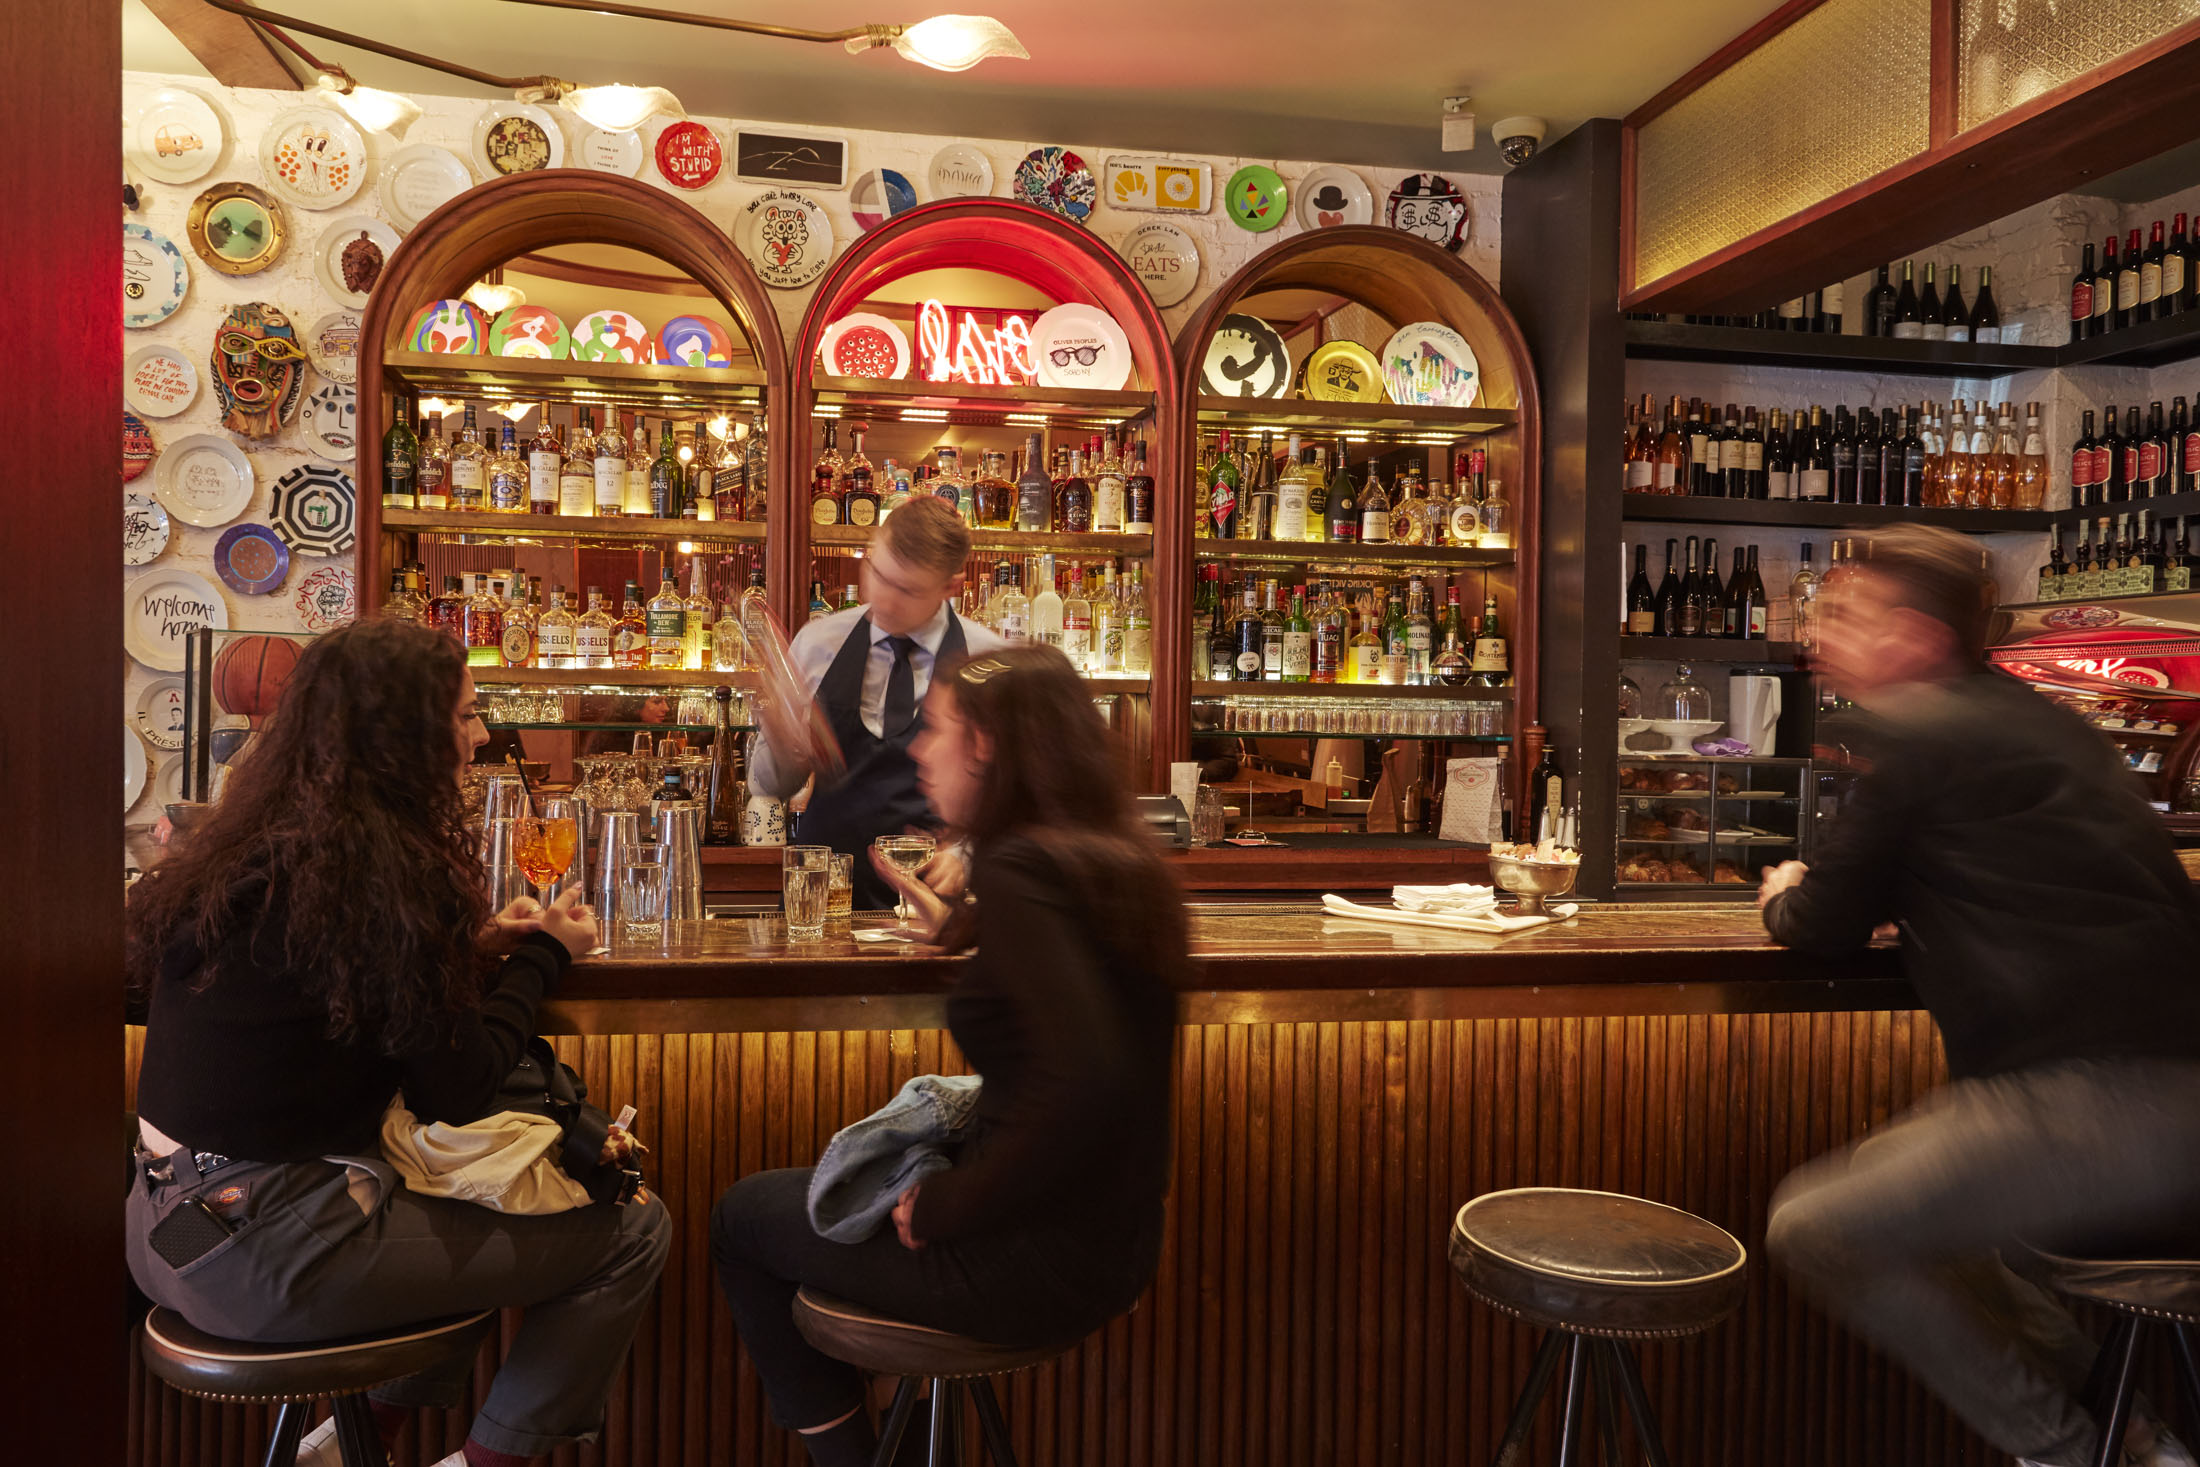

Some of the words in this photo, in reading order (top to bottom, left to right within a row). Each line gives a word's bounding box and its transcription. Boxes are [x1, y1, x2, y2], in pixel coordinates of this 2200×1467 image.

[682, 145, 711, 157] WITH
[670, 157, 712, 172] STUPID
[1137, 225, 1161, 236] DEREK
[1164, 226, 1179, 237] LAM
[1133, 256, 1180, 273] EATS
[144, 594, 215, 623] Welcome
[137, 711, 146, 724] IL
